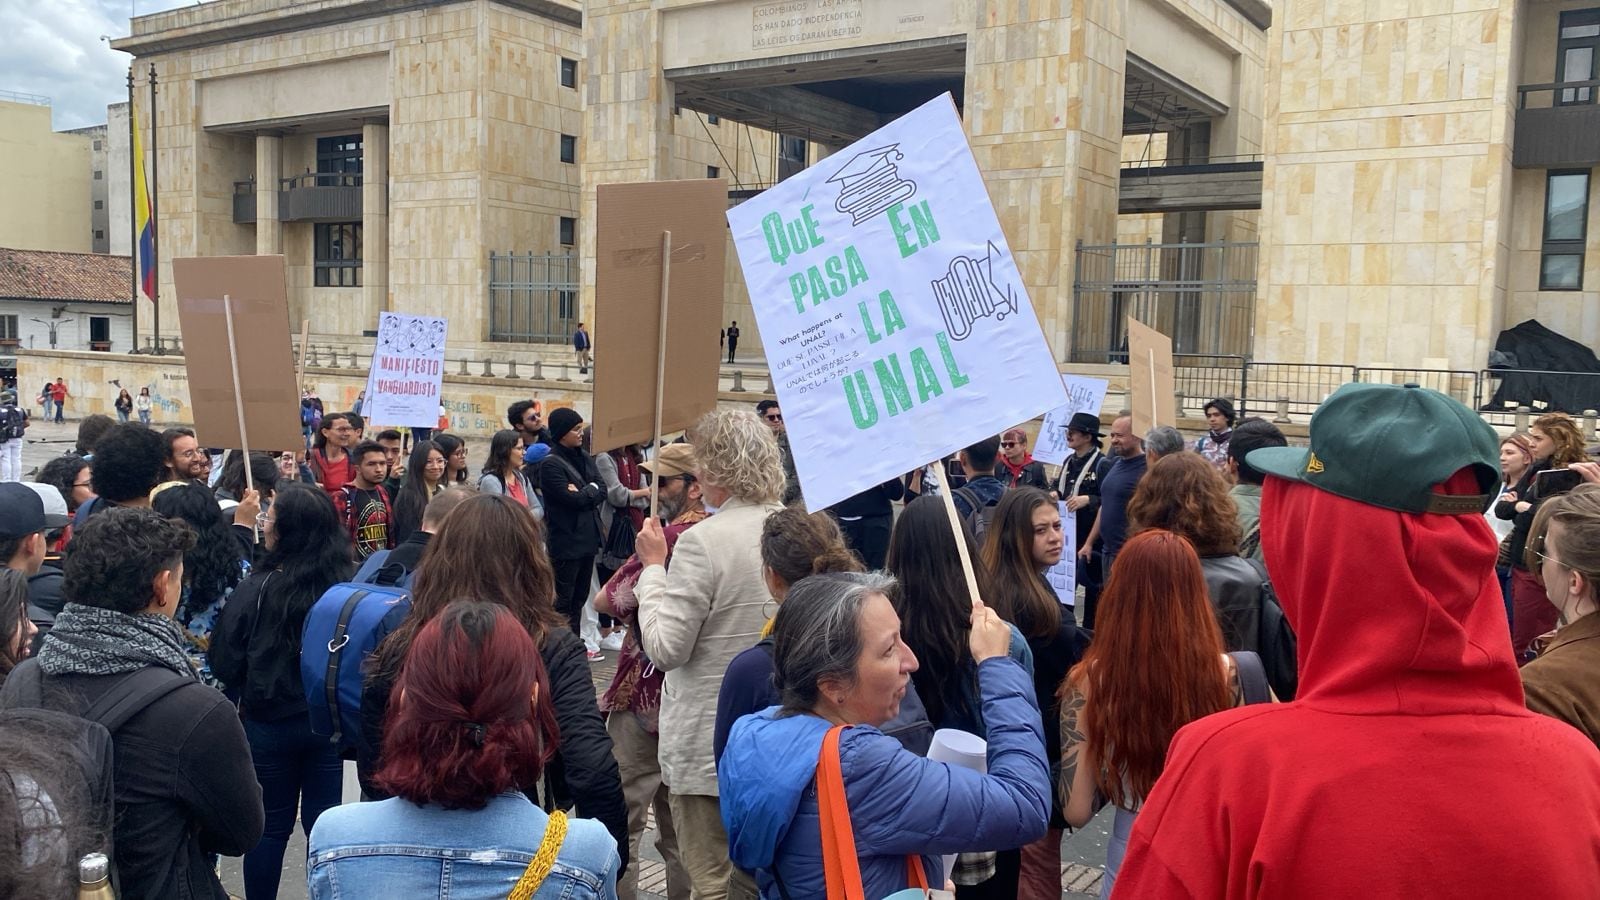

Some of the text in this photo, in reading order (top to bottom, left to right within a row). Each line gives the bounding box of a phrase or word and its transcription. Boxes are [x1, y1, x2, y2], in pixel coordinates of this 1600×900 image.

[753, 2, 808, 18] COLOMBIANOS
[753, 10, 863, 32] OS HAN DADO INDEPENDENCIA
[752, 38, 766, 48] LAS
[801, 30, 827, 41] DARAN
[827, 26, 862, 38] LIBERTAD
[789, 200, 941, 314] PASA EN
[858, 289, 906, 344] LA
[779, 312, 844, 346] What happens at
[800, 330, 826, 347] UNAL?
[381, 355, 439, 377] MANIFIESTO
[377, 379, 437, 398] VANGUARDISTA
[842, 331, 970, 430] UNAL
